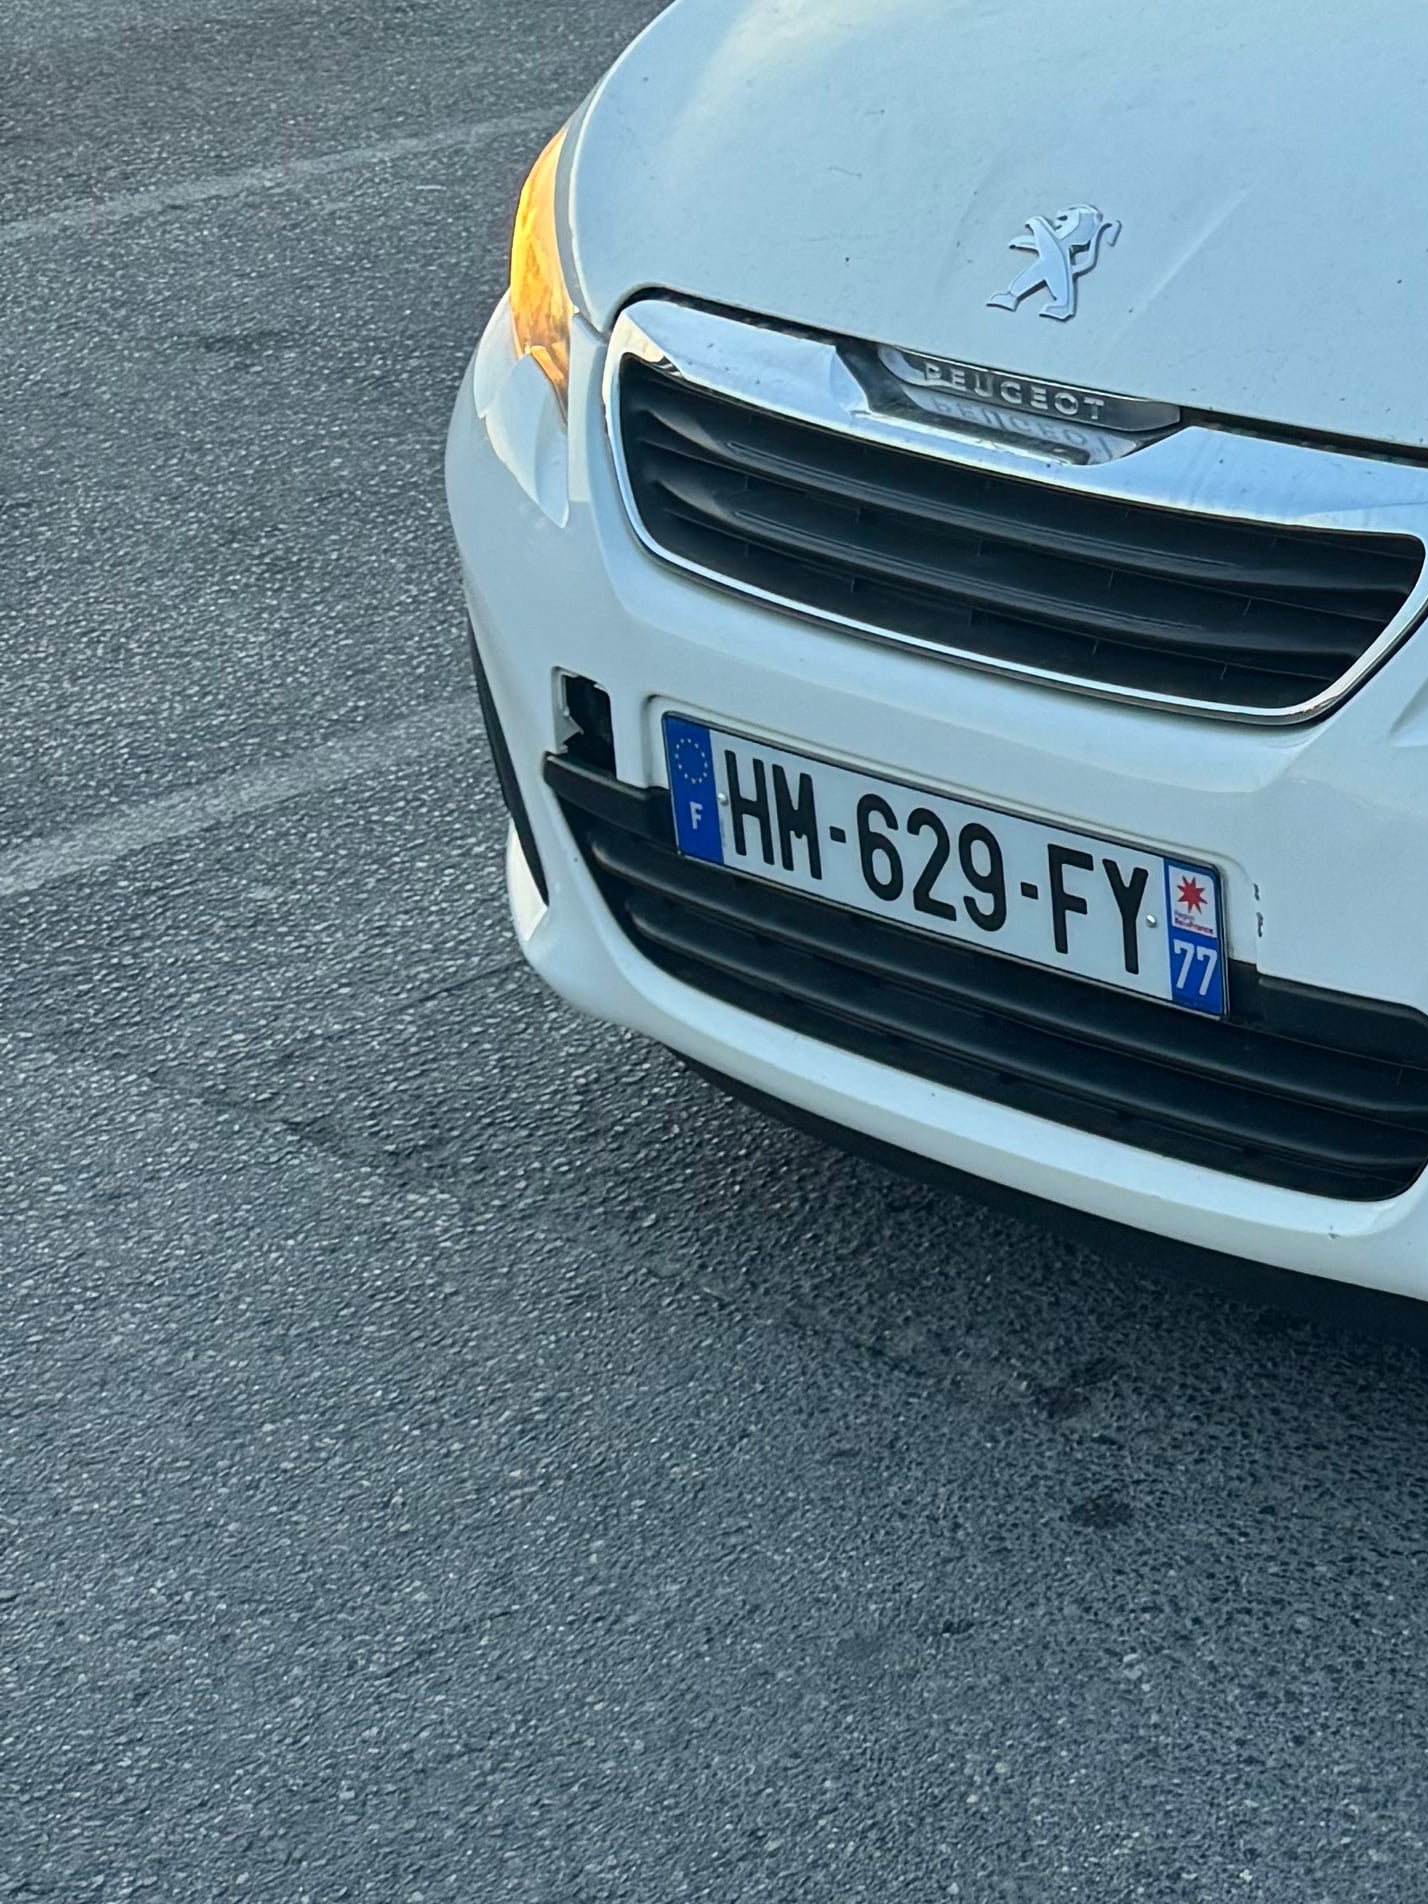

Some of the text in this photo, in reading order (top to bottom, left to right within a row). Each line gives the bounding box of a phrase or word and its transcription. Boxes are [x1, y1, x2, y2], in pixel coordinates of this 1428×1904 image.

[923, 362, 1105, 421] PEUGEOT
[690, 802, 704, 832] F
[724, 749, 1150, 976] HM-629-FY
[1172, 939, 1218, 996] 77
